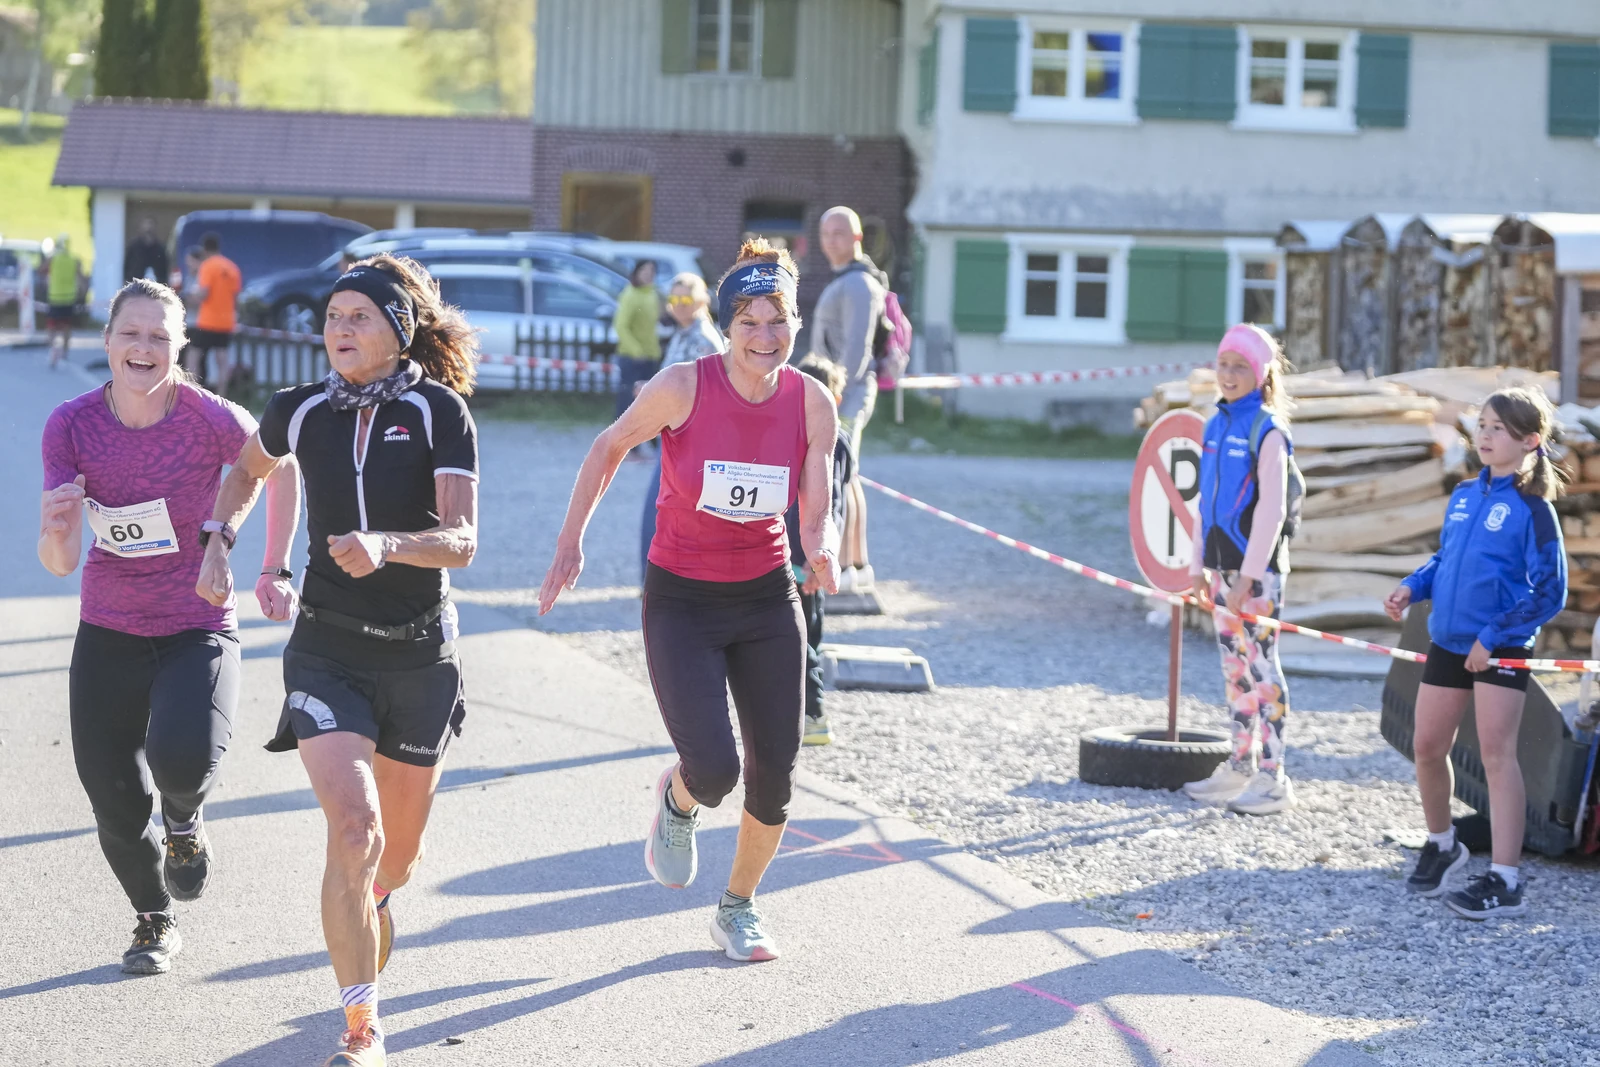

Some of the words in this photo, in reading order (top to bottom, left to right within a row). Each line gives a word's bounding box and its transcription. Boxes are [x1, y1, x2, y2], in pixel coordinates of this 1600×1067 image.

[741, 282, 760, 292] AQUA
[729, 485, 758, 508] 91
[1169, 449, 1201, 556] P
[110, 523, 143, 542] 60
[122, 542, 158, 551] Voralpencup
